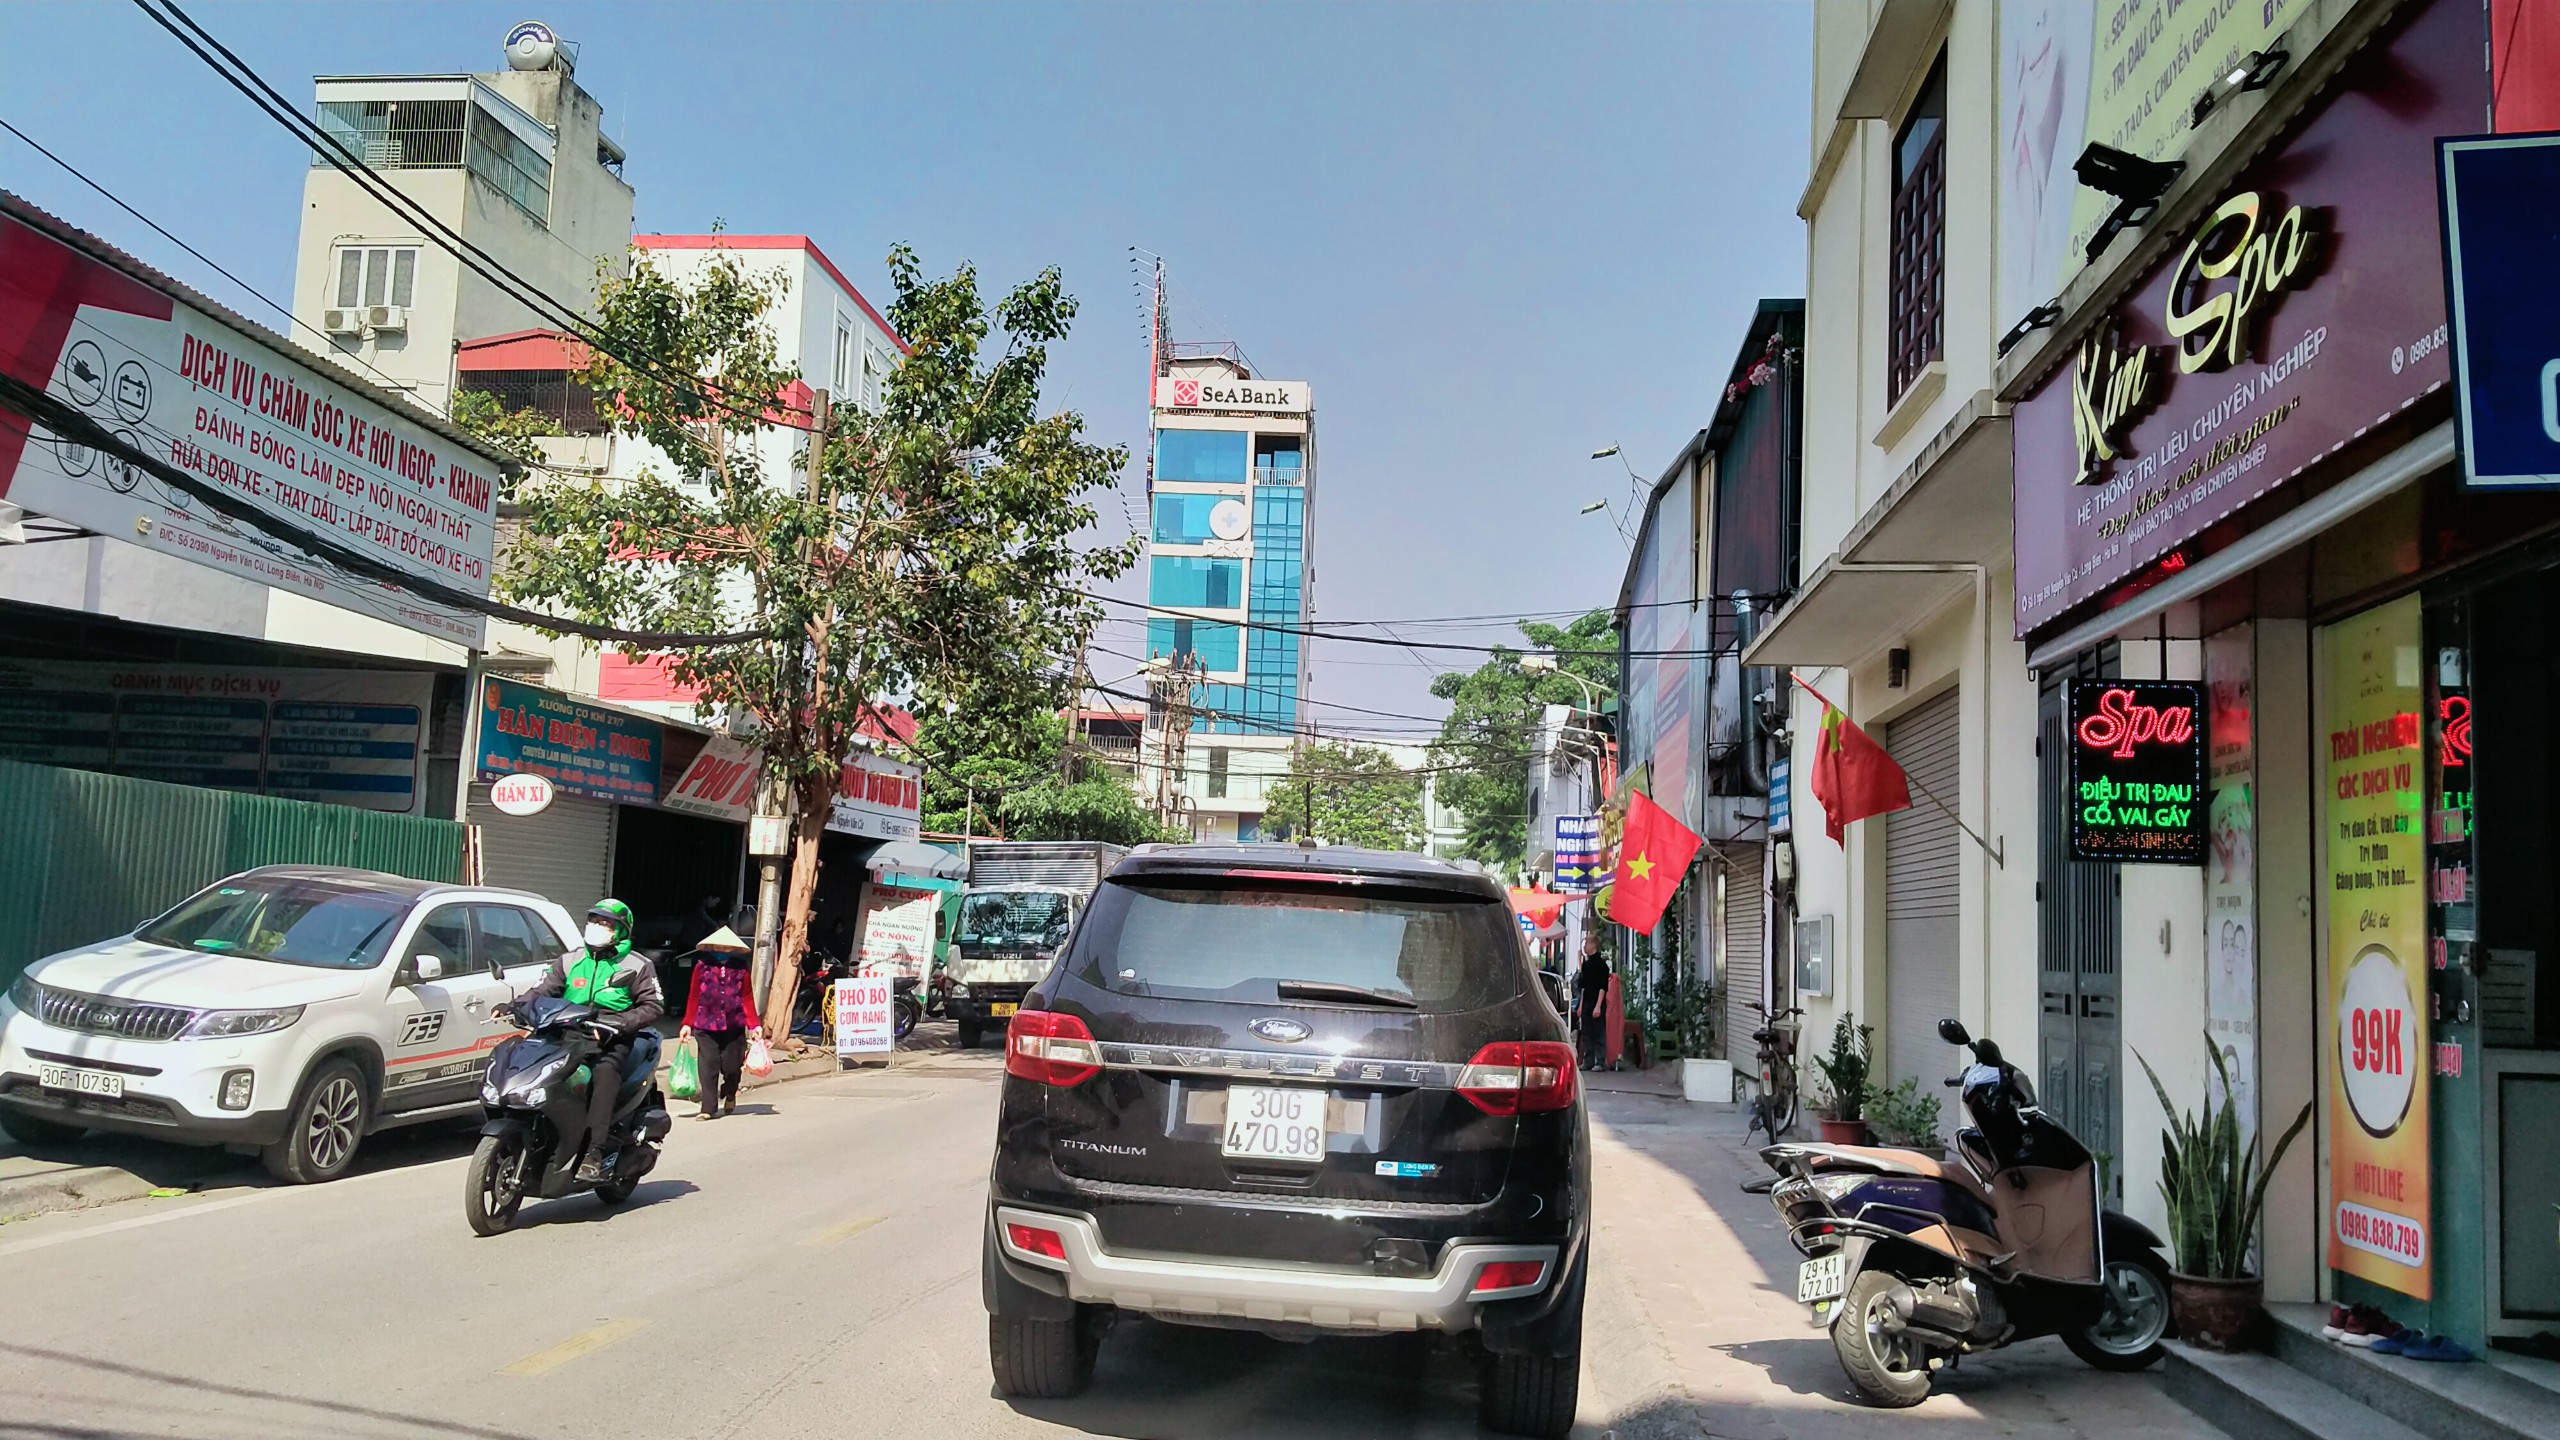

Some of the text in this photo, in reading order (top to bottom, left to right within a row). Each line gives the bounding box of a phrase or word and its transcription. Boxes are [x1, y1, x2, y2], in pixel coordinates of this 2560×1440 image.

[2192, 6, 2217, 55] GIAO
[2128, 26, 2147, 76] ĐAU
[2072, 192, 2308, 485] Kim Spa
[1202, 386, 1289, 405] SeABank
[180, 333, 228, 393] DỊCH
[231, 357, 256, 415] VỤ
[259, 375, 310, 432] CHĂM
[311, 395, 344, 448] SÓC
[346, 414, 368, 458] XE
[368, 427, 396, 471] HƠI
[397, 440, 436, 493] NGỌC
[448, 463, 490, 514] KHANH
[2094, 468, 2135, 515] THỐNG
[2136, 453, 2158, 481] TRỊ
[2159, 426, 2189, 465] LIỆU
[2192, 382, 2255, 442] CHUYÊN
[2260, 325, 2328, 389] NGHIỆP
[195, 407, 472, 543] ĐÁNH BÓNG LÀM ĐẸP NỘI NGOẠI THẤT
[171, 434, 203, 474] RỬA
[207, 453, 240, 487] DỌN
[242, 467, 262, 496] XE
[275, 481, 310, 513] THAY
[311, 491, 338, 525] DẦU
[348, 505, 372, 537] LẮP
[375, 519, 399, 549] ĐẶT
[400, 527, 418, 556] ĐỒ
[419, 538, 446, 567] CHƠI
[447, 550, 462, 573] XE
[464, 557, 483, 580] HƠI
[159, 527, 176, 543] Đ/C:
[178, 534, 188, 547] Số
[267, 564, 285, 581] Long
[303, 575, 313, 586] Hà
[313, 577, 325, 590] Nội
[112, 673, 281, 698] DANH MỤC DỊCH VỤ
[538, 698, 573, 715] XƯỞNG
[591, 710, 606, 723] KHÍ
[2080, 689, 2193, 758] Spa
[496, 704, 546, 741] HÀN
[548, 717, 598, 753] ĐIỆN
[608, 732, 652, 761] INOX
[2330, 720, 2359, 762] TRẢI
[677, 746, 755, 803] PHỞ
[2080, 775, 2192, 804] ĐIỀU TRỊ ĐAU
[2338, 763, 2411, 800] CÁC DỊCH VỤ
[497, 783, 527, 803] HÀN
[529, 782, 545, 802] XÌ
[2083, 800, 2116, 827] CỔ,
[2119, 807, 2153, 827] VAI,
[2352, 820, 2365, 838] đau
[2359, 843, 2389, 866] Trị Mụn
[993, 952, 1022, 960] ISUZU
[839, 981, 887, 1006] PHỞ BÒ
[92, 1013, 110, 1024] KIA
[839, 1010, 887, 1025] CƠM RANG
[2352, 1007, 2403, 1076] 99K
[42, 1068, 120, 1094] 30F-107.93
[449, 1061, 471, 1075] DRIFT
[1128, 1049, 1430, 1082] EVEREST
[1250, 1089, 1302, 1121] 30G
[1060, 1138, 1147, 1156] TITANIUM
[1227, 1121, 1320, 1156] 470.98
[2354, 1161, 2404, 1202] HOTLINE
[2340, 1208, 2420, 1259] 0989.838.799
[1804, 1256, 1838, 1280] 29-K1
[1800, 1275, 1840, 1300] 472.01
